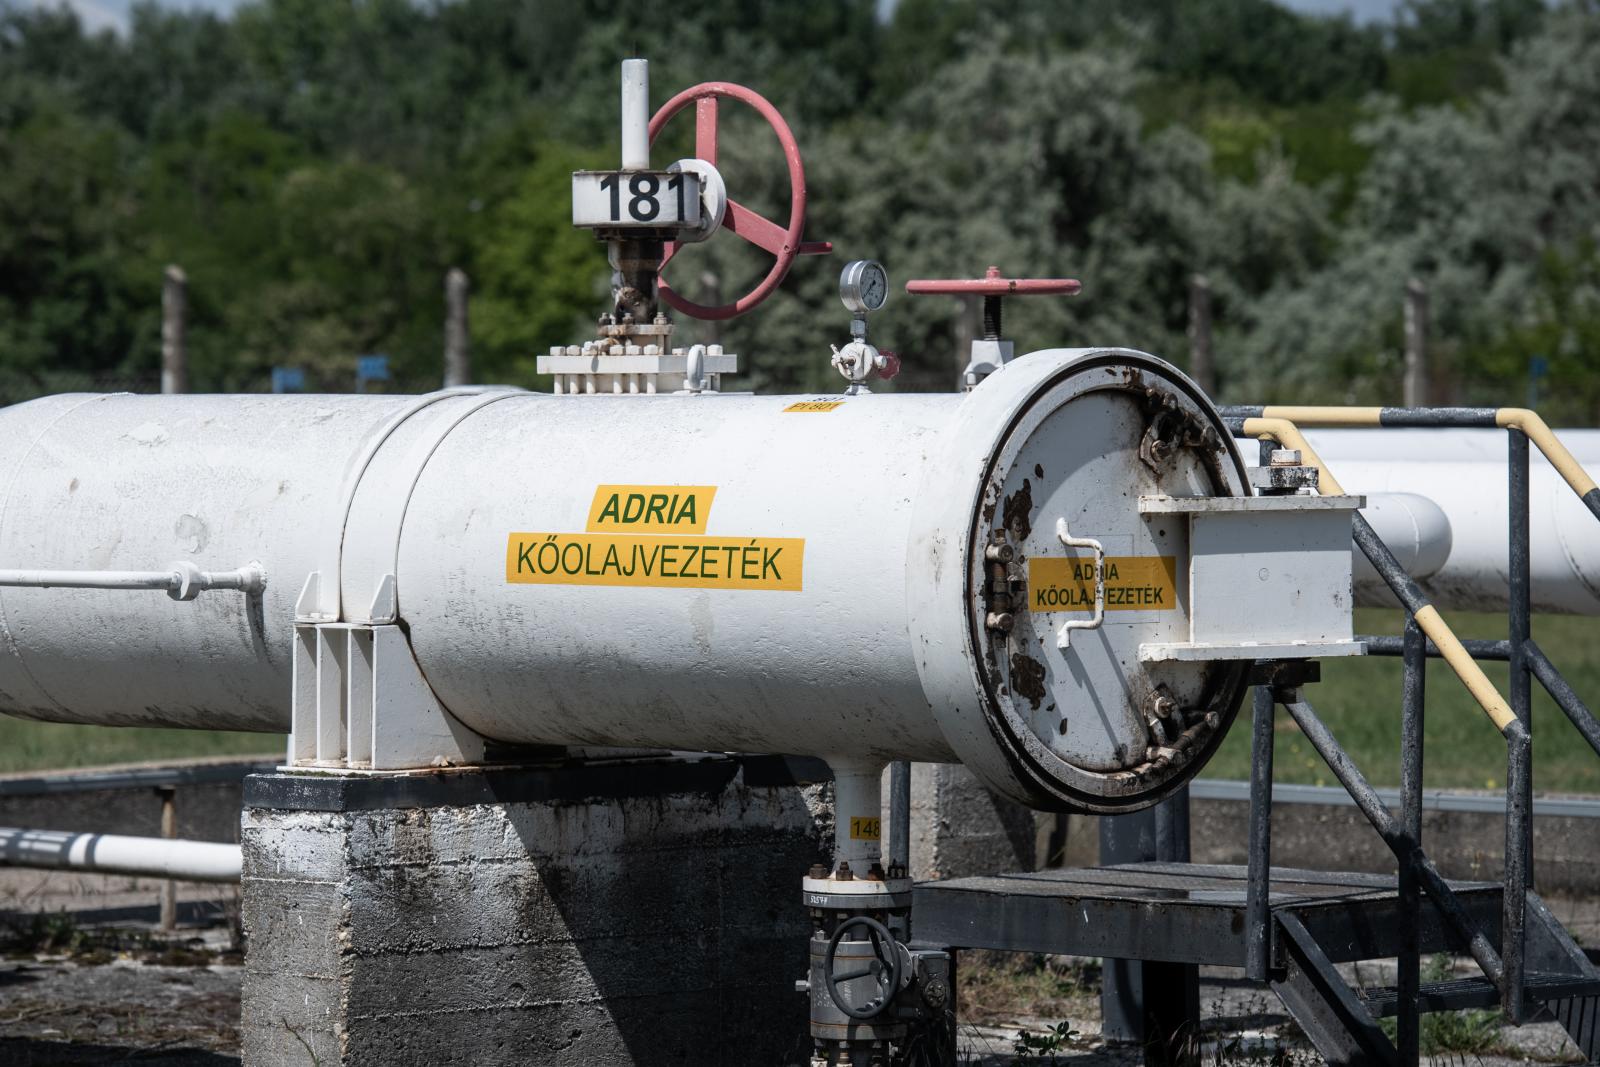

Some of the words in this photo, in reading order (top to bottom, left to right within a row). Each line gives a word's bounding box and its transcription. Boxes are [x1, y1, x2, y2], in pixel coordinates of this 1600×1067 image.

[600, 173, 685, 222] 181
[597, 493, 697, 525] ADRIA
[517, 535, 783, 580] KŐOLAJVEZETÉK
[1073, 563, 1120, 581] ADIA
